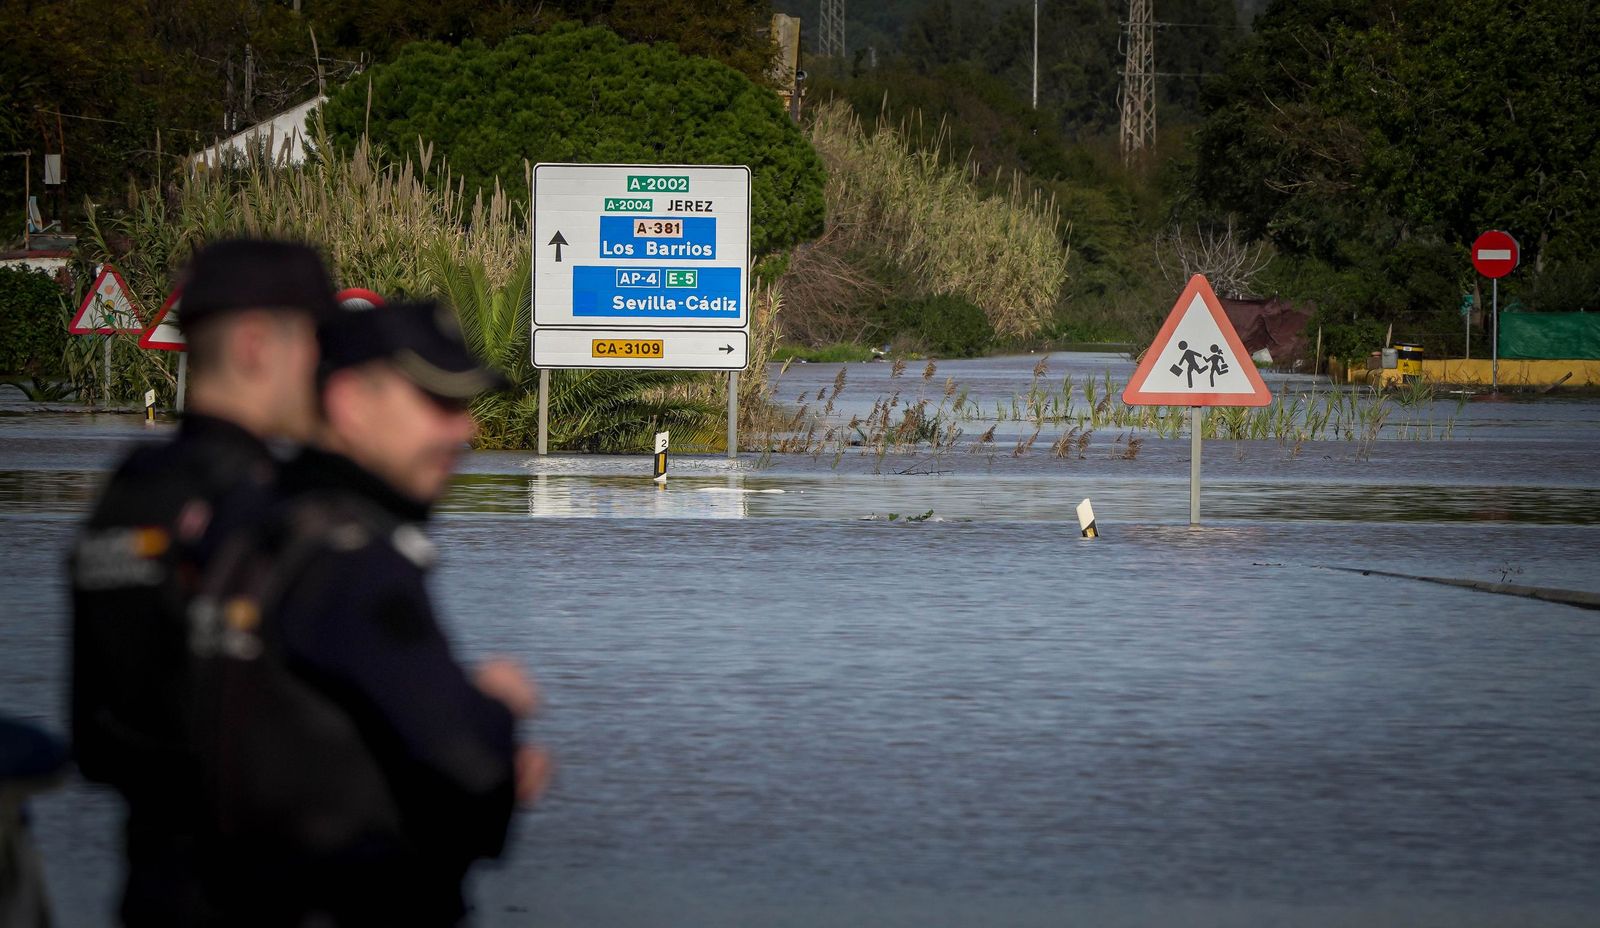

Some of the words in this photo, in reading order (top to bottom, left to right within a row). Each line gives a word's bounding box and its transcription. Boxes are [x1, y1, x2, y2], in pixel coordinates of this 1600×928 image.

[630, 178, 687, 190] A-2002
[606, 200, 651, 210] A-2004
[667, 200, 713, 212] JEREZ
[636, 222, 680, 234] A-381
[603, 241, 634, 255] Los
[646, 241, 712, 256] Barrios
[620, 272, 657, 285] AP-4
[668, 272, 694, 285] E-5
[612, 295, 737, 311] Sevilla-Cádiz
[596, 342, 660, 355] CA-3109
[661, 439, 667, 448] 2
